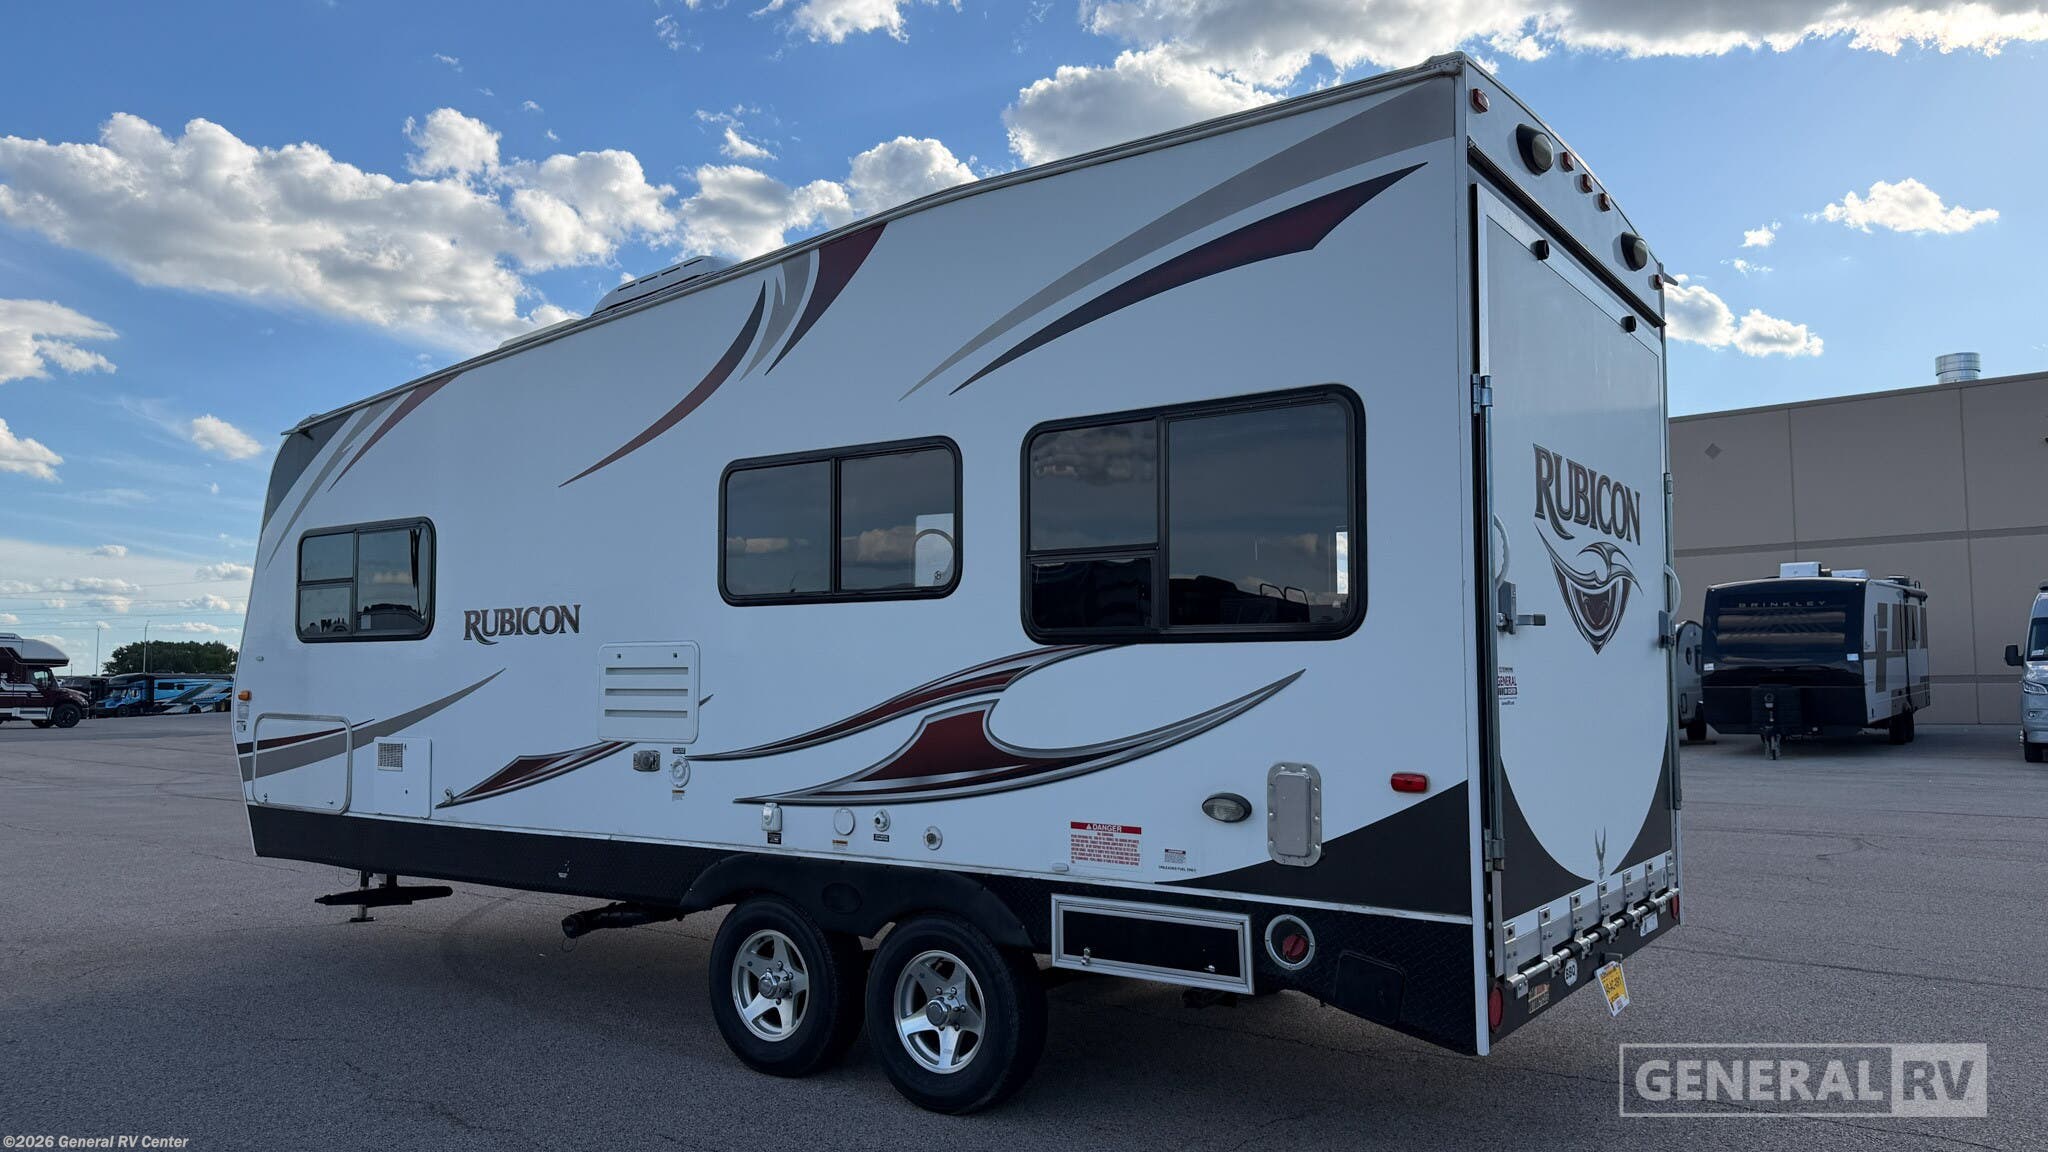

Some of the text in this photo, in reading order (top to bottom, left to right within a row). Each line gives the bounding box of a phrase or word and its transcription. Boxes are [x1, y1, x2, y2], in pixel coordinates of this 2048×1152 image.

[1533, 442, 1640, 546] RUBICON
[463, 604, 581, 645] RUBICON
[1092, 823, 1122, 833] DANGER
